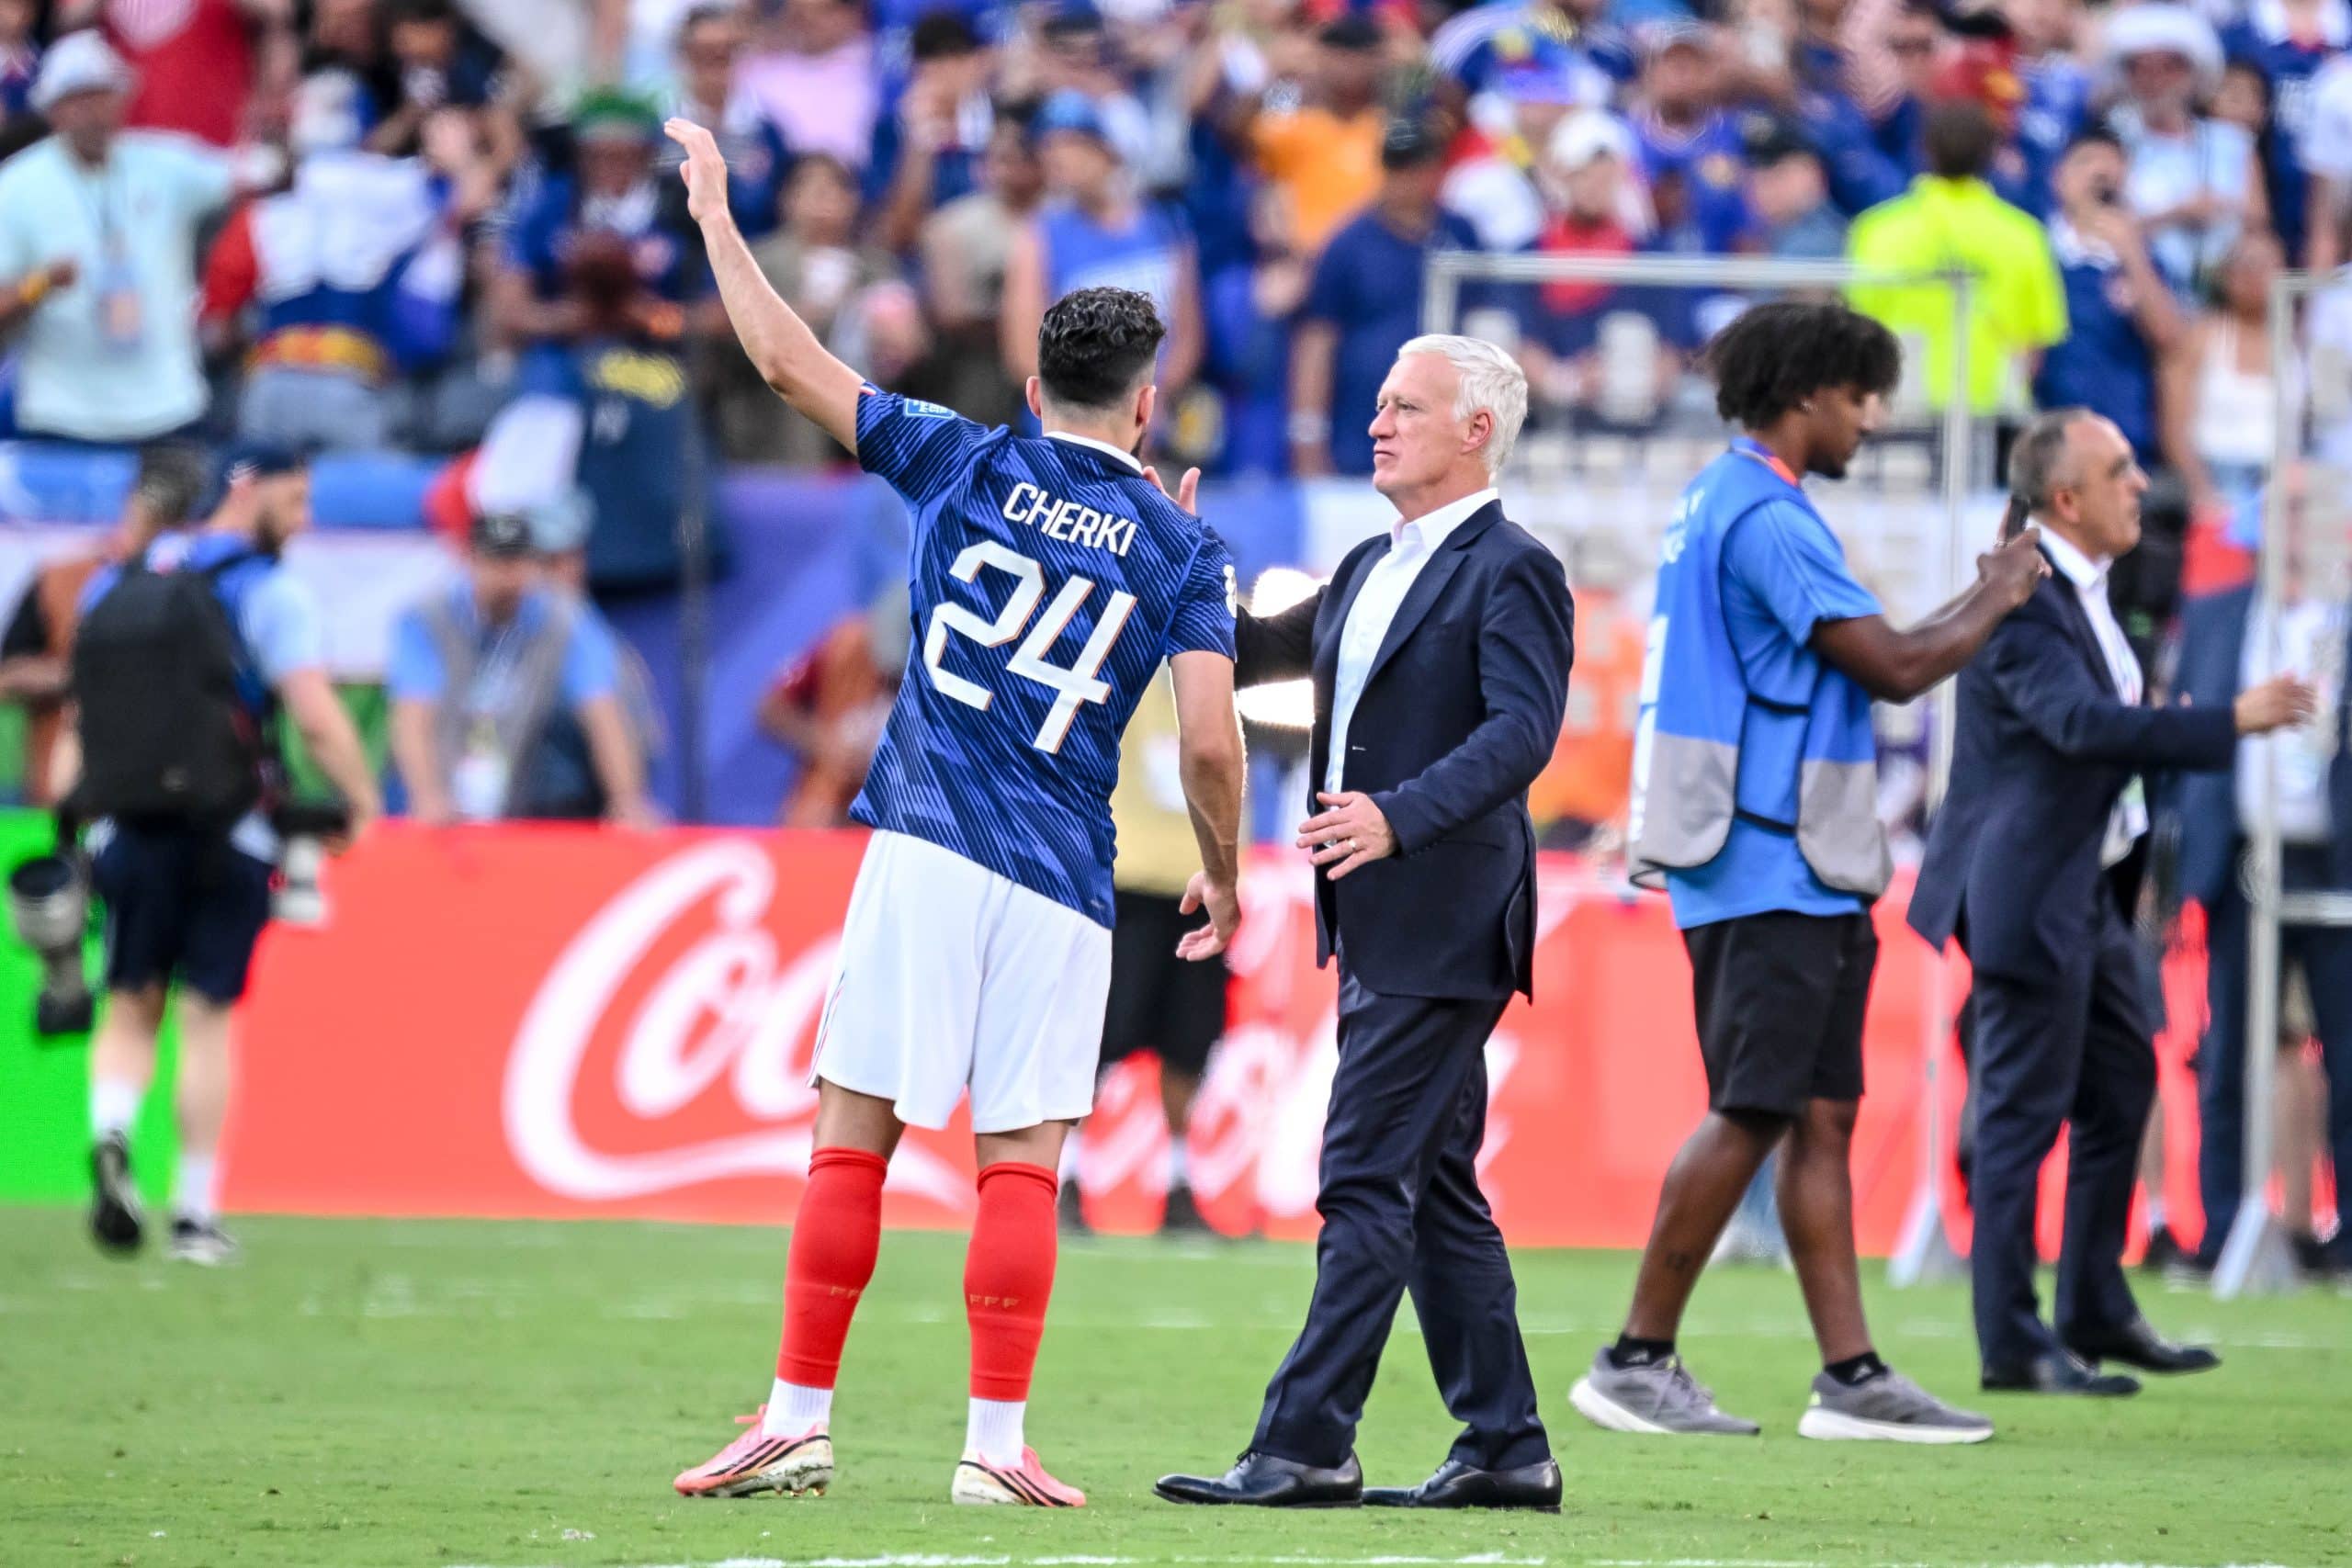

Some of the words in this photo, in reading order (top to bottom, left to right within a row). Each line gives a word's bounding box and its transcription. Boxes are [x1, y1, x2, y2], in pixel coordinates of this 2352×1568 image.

[1003, 482, 1137, 557] CHERKI
[923, 540, 1138, 754] 24
[969, 1293, 1022, 1309] FFF
